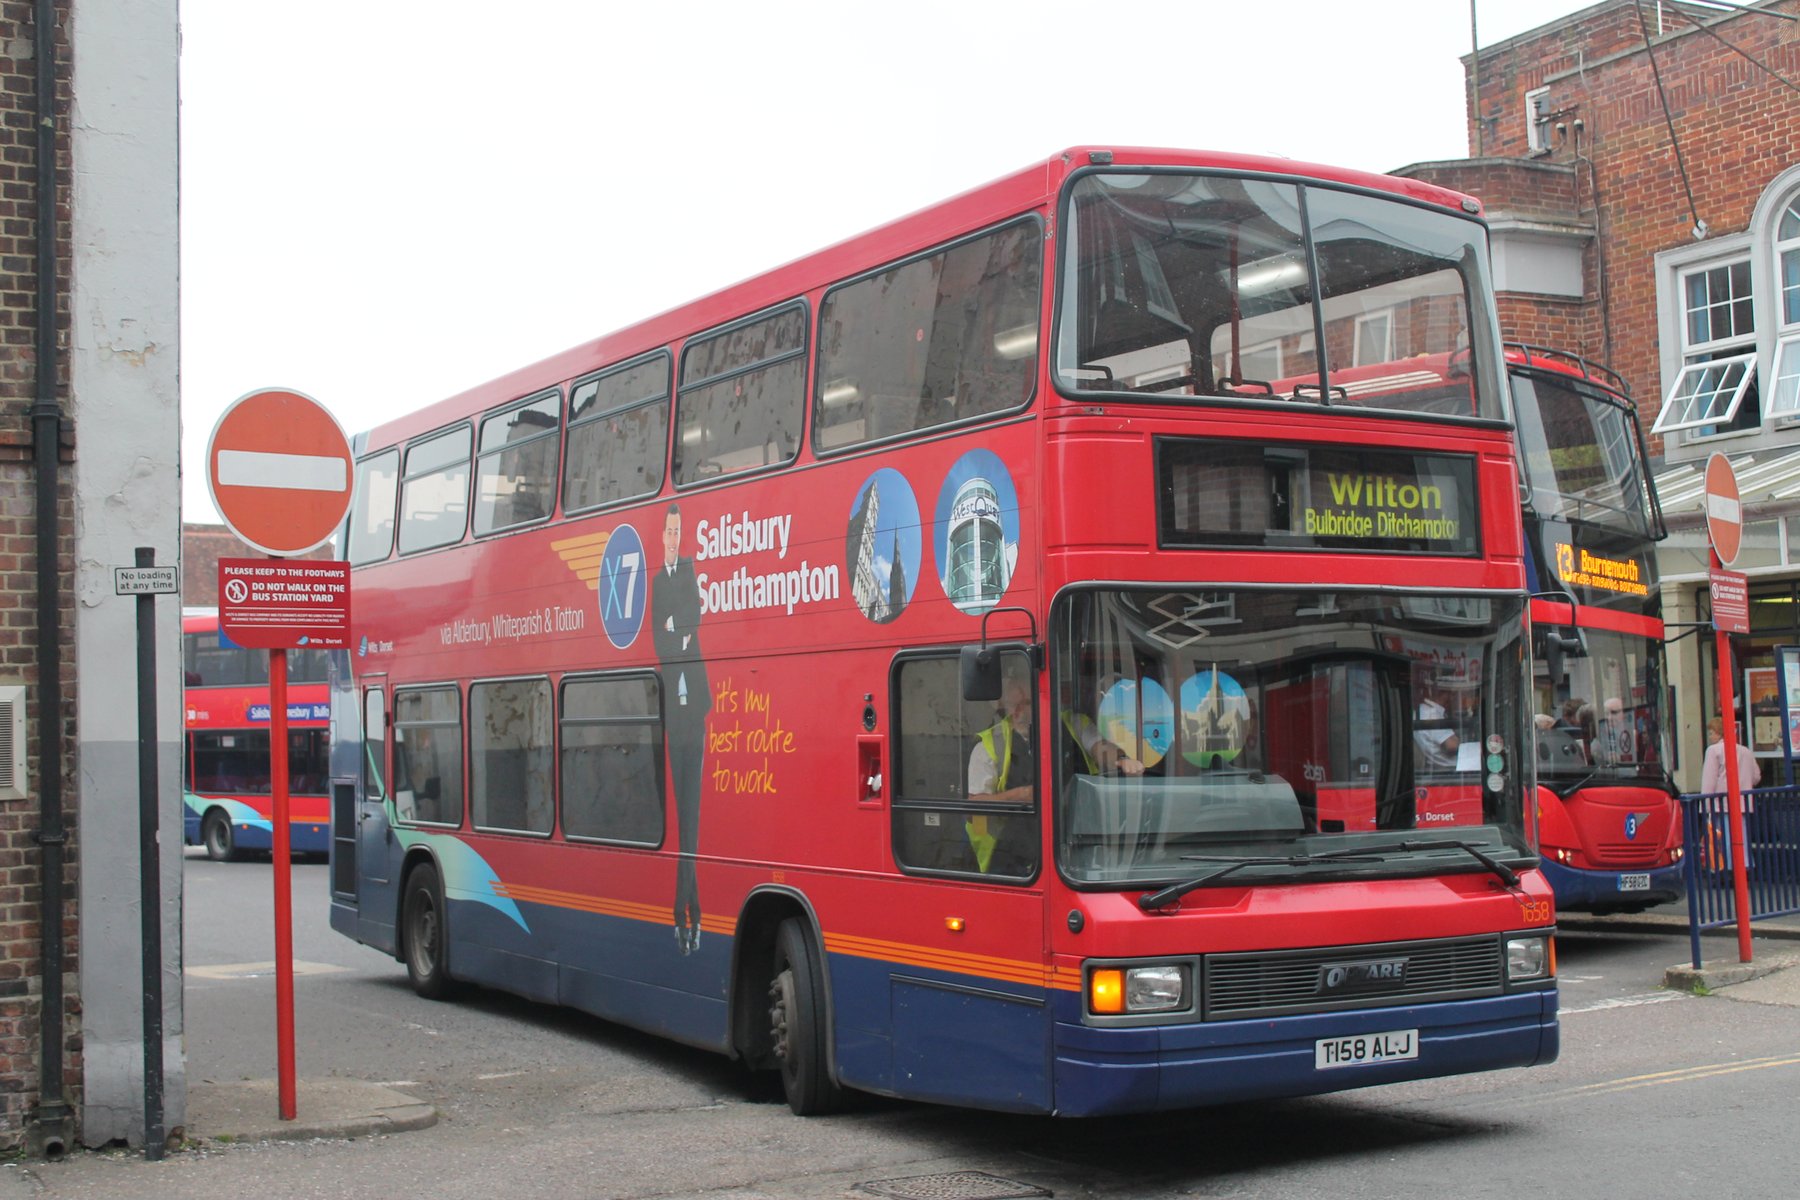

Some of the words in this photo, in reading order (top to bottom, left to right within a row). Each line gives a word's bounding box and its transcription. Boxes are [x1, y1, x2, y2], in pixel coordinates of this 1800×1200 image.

[1328, 473, 1441, 509] Wilton
[696, 510, 792, 561] Salisbury
[1305, 508, 1372, 537] Bulbridge
[121, 572, 134, 580] No
[138, 571, 171, 580] loading
[225, 567, 254, 575] PLEASE
[255, 568, 275, 576] KEEP
[276, 568, 287, 576] TO
[288, 569, 303, 577] THE
[304, 569, 345, 578] FOOTWAYS
[1581, 549, 1638, 581] Bournemouth
[252, 582, 265, 591] DO
[267, 583, 285, 591] NOT
[286, 583, 311, 592] WALK
[313, 584, 327, 592] ON
[327, 584, 345, 593] THE
[252, 592, 270, 601] BUS
[272, 593, 309, 602] STATION
[310, 594, 334, 603] YARD
[605, 552, 640, 621] X7
[697, 560, 839, 615] Southampton
[440, 625, 452, 645] via
[452, 620, 491, 646] Alderbury,
[492, 609, 542, 641] Whiteparish
[544, 608, 553, 633] &
[554, 607, 584, 631] Totton
[715, 676, 738, 713] it's
[745, 688, 770, 728] my
[710, 720, 742, 754] best
[747, 719, 796, 754] route
[712, 760, 731, 792] to
[734, 757, 777, 794] work
[1425, 811, 1455, 822] Dorset
[1520, 901, 1549, 922] 1658
[1327, 963, 1404, 988] OARE
[1323, 1038, 1365, 1063] T158
[1372, 1033, 1410, 1057] ALJ
